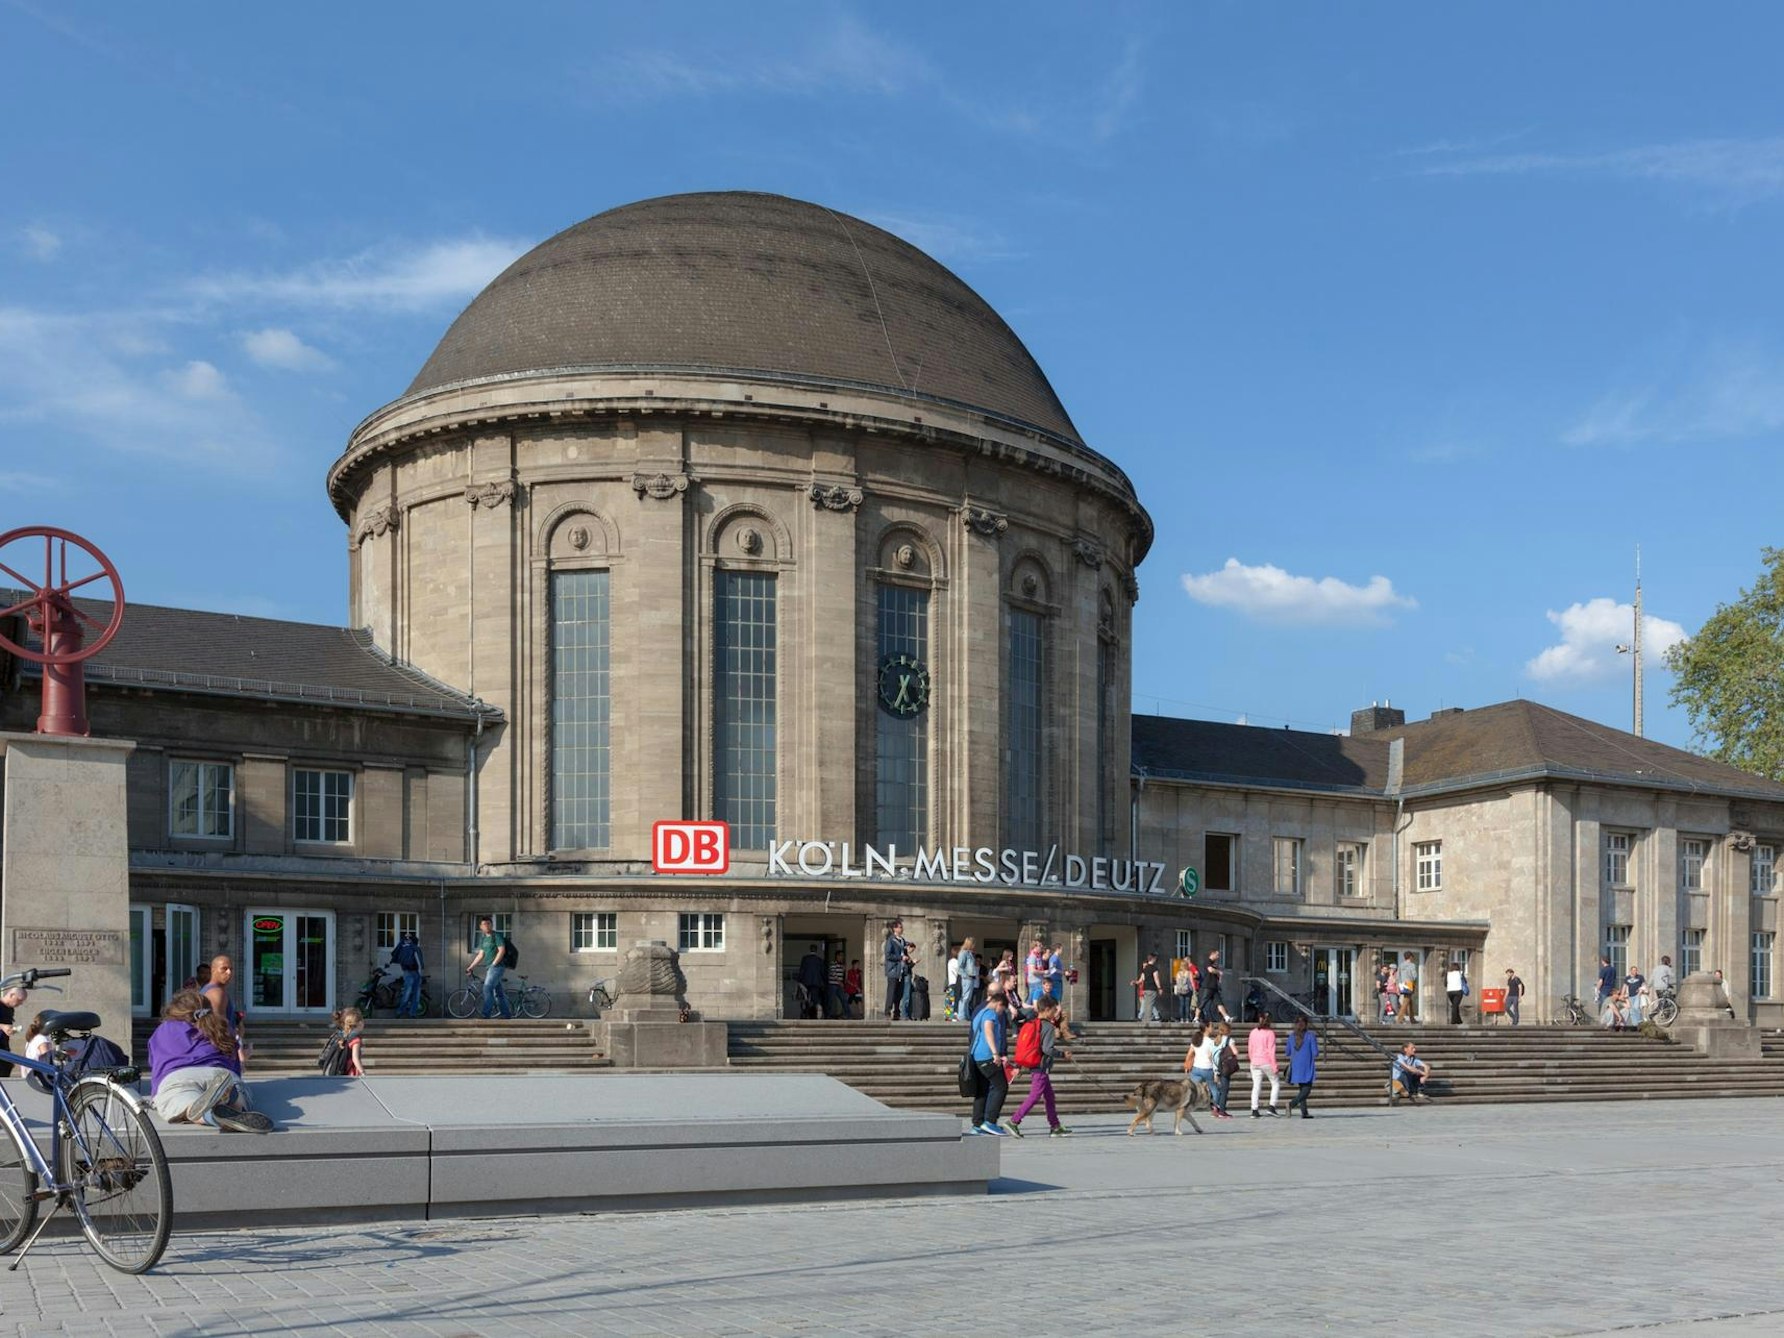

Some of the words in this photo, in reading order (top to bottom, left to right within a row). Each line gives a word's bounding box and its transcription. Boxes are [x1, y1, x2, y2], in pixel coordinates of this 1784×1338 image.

[662, 828, 720, 866] DB
[768, 839, 896, 877] KÖLN
[95, 934, 119, 942] OTTO
